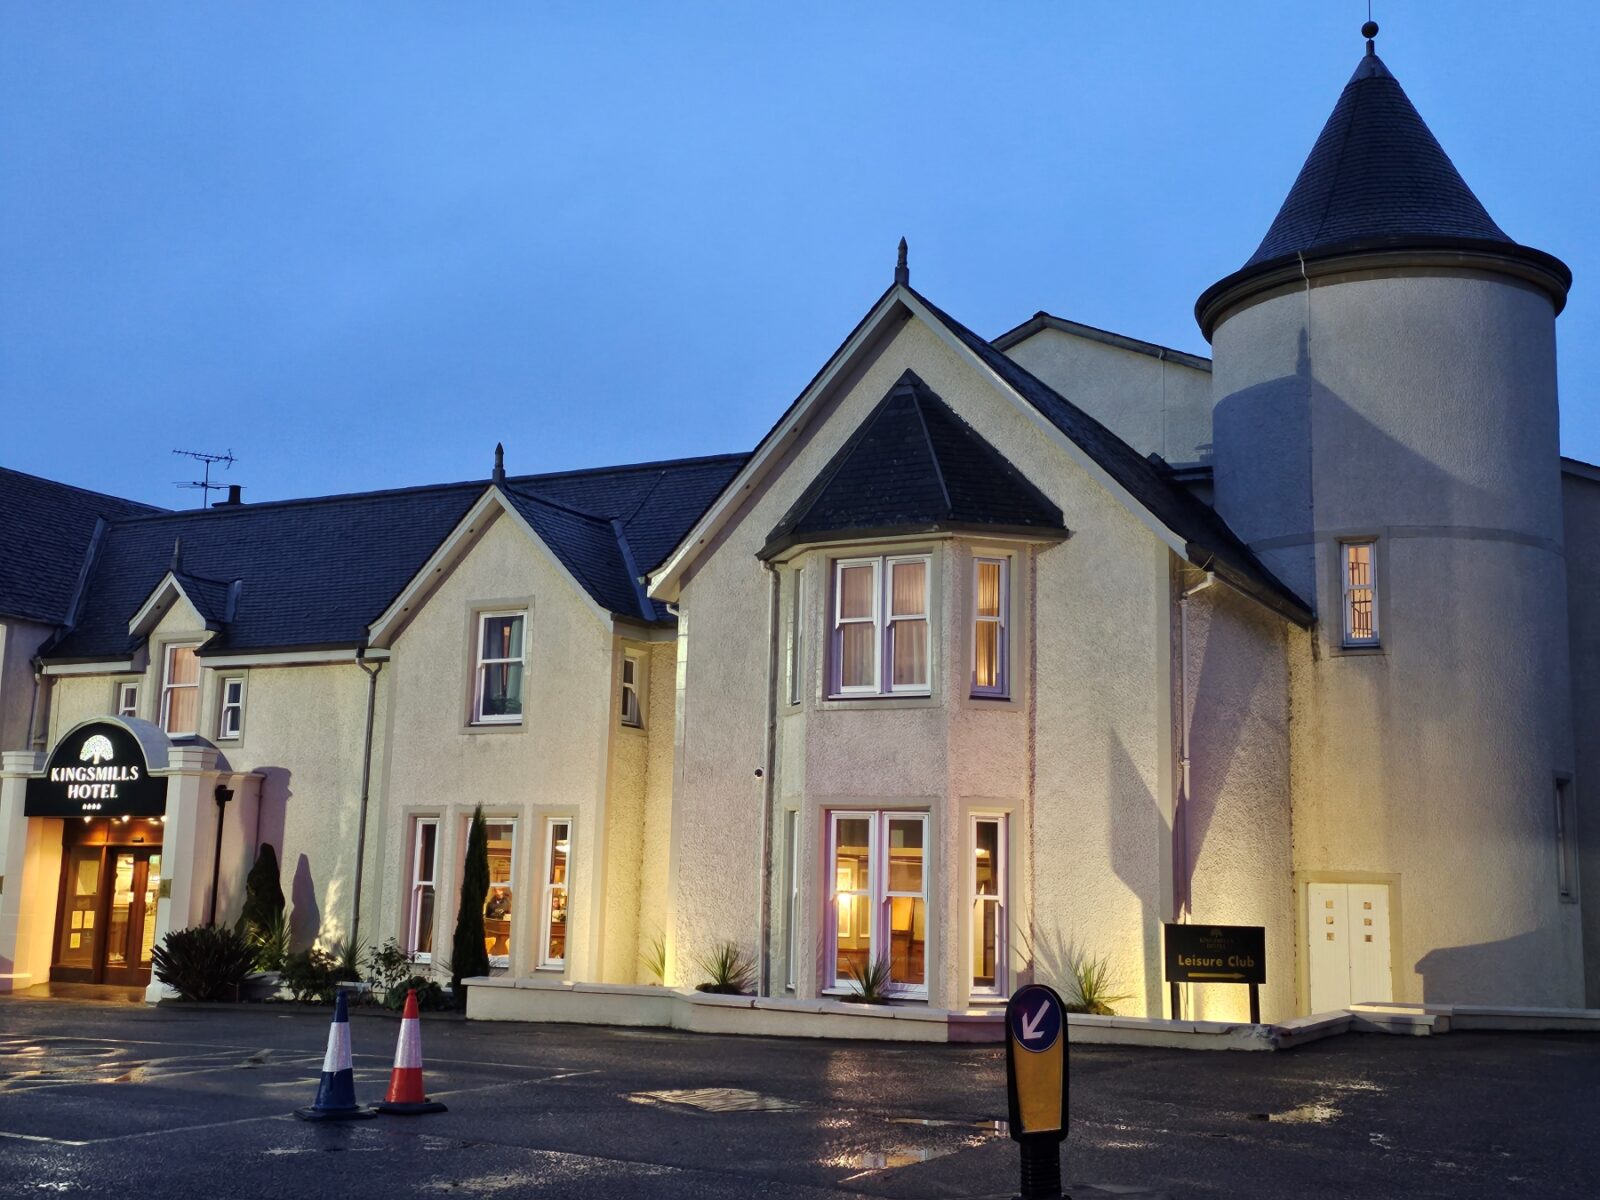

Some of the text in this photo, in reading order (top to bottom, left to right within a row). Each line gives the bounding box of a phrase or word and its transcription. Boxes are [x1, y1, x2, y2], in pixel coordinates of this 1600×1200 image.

[51, 766, 139, 782] KINGSMILLS
[67, 784, 118, 799] HOTEL
[1178, 955, 1255, 967] Leisure Club
